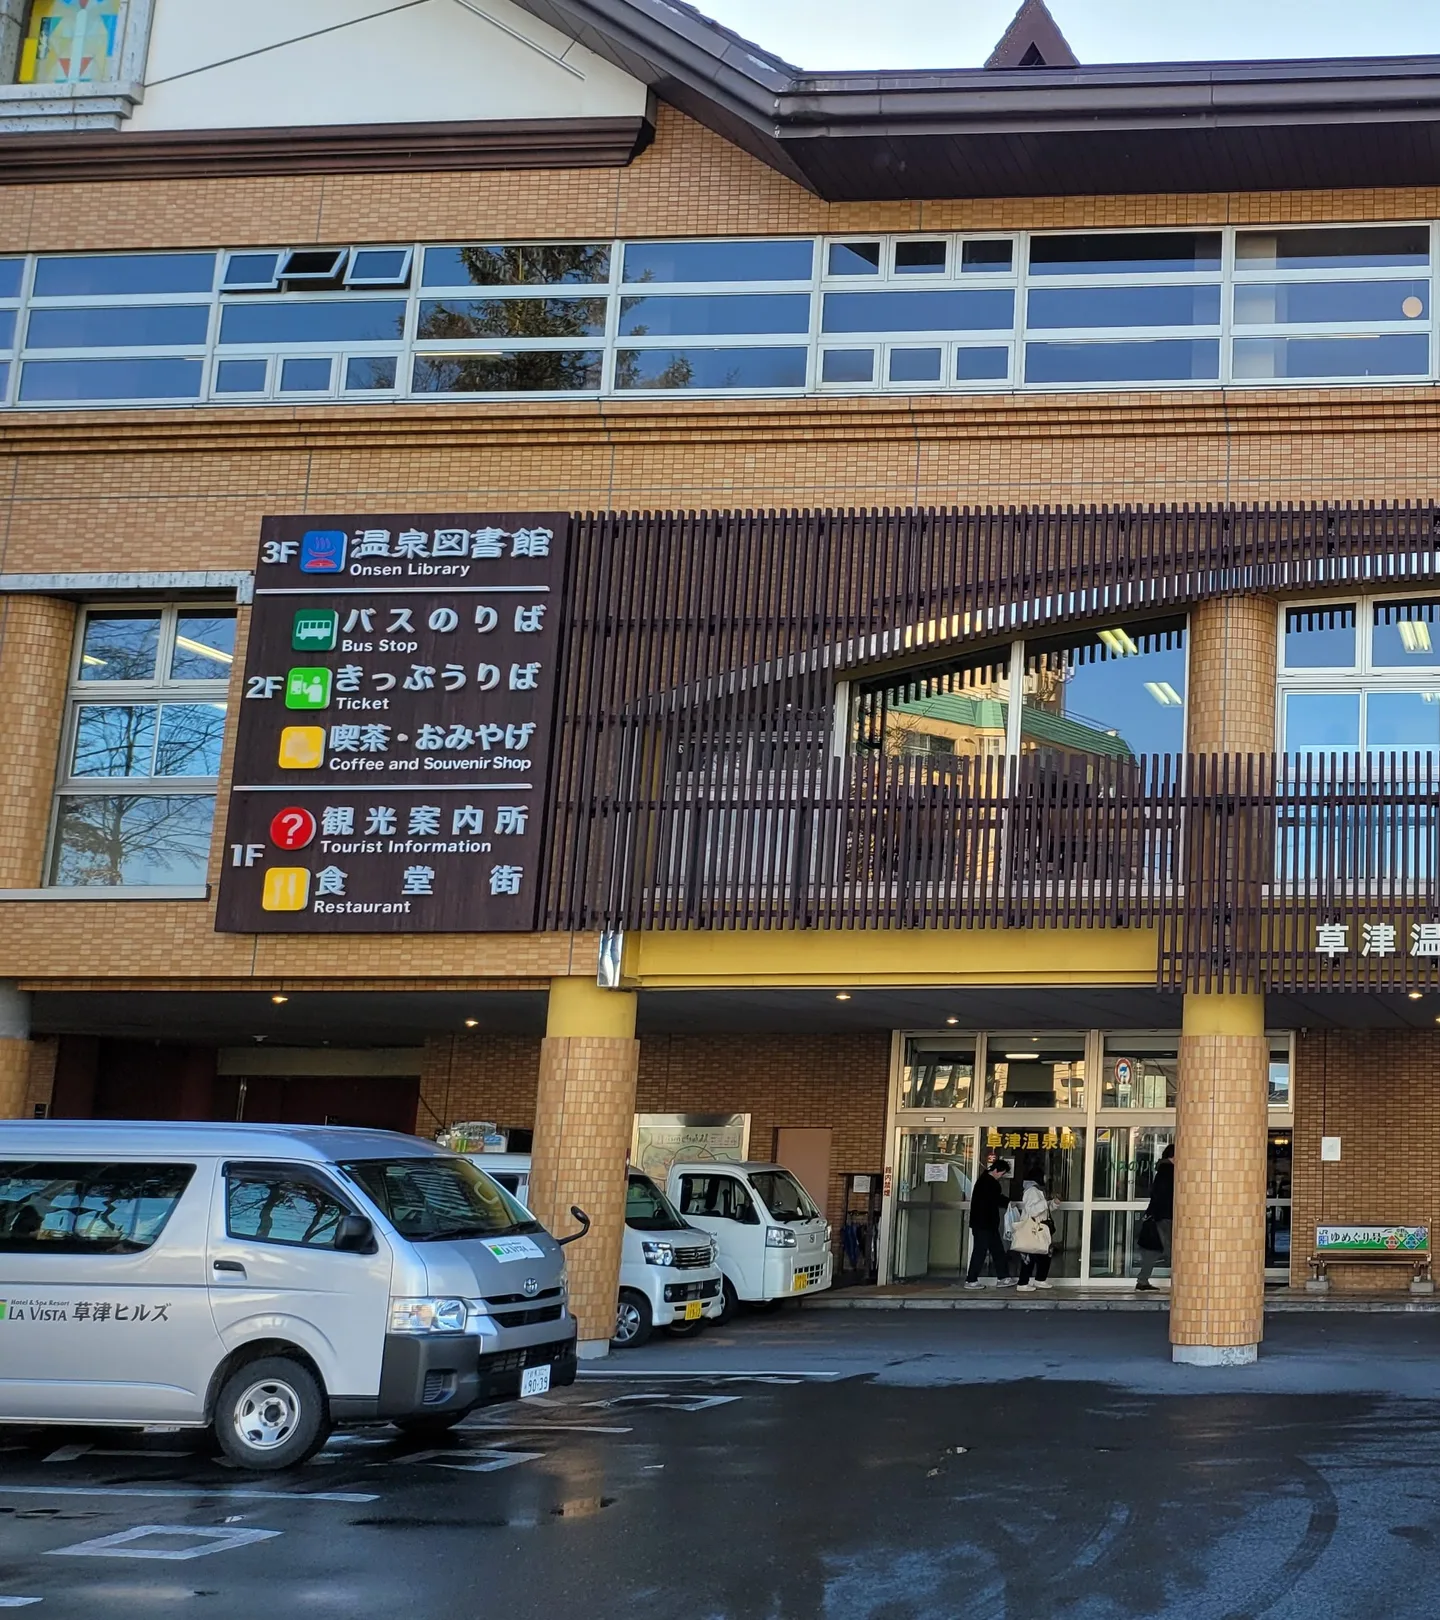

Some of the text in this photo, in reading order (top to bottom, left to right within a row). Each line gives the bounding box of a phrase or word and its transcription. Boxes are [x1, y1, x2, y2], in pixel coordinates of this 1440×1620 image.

[262, 541, 299, 565] 3F
[350, 527, 554, 560] 温泉図書館
[350, 562, 470, 577] Onsen Library
[342, 604, 547, 634] バスのりば
[342, 638, 418, 654] Bus Stop
[246, 676, 284, 699] 2F
[336, 661, 542, 692] きっぷうりば
[336, 697, 389, 710] Ticket
[328, 721, 537, 752] 喫茶・おみやげ
[329, 756, 532, 772] Coffee and Souvenir Shop
[321, 805, 530, 837] 観光案内所
[231, 844, 265, 868] 1F
[320, 839, 492, 854] Tourist Information
[314, 900, 411, 914] Restaurant
[1330, 1232, 1382, 1244] ゆめぐり号
[9, 1301, 173, 1322] LA VISTA 草津ヒルズ
